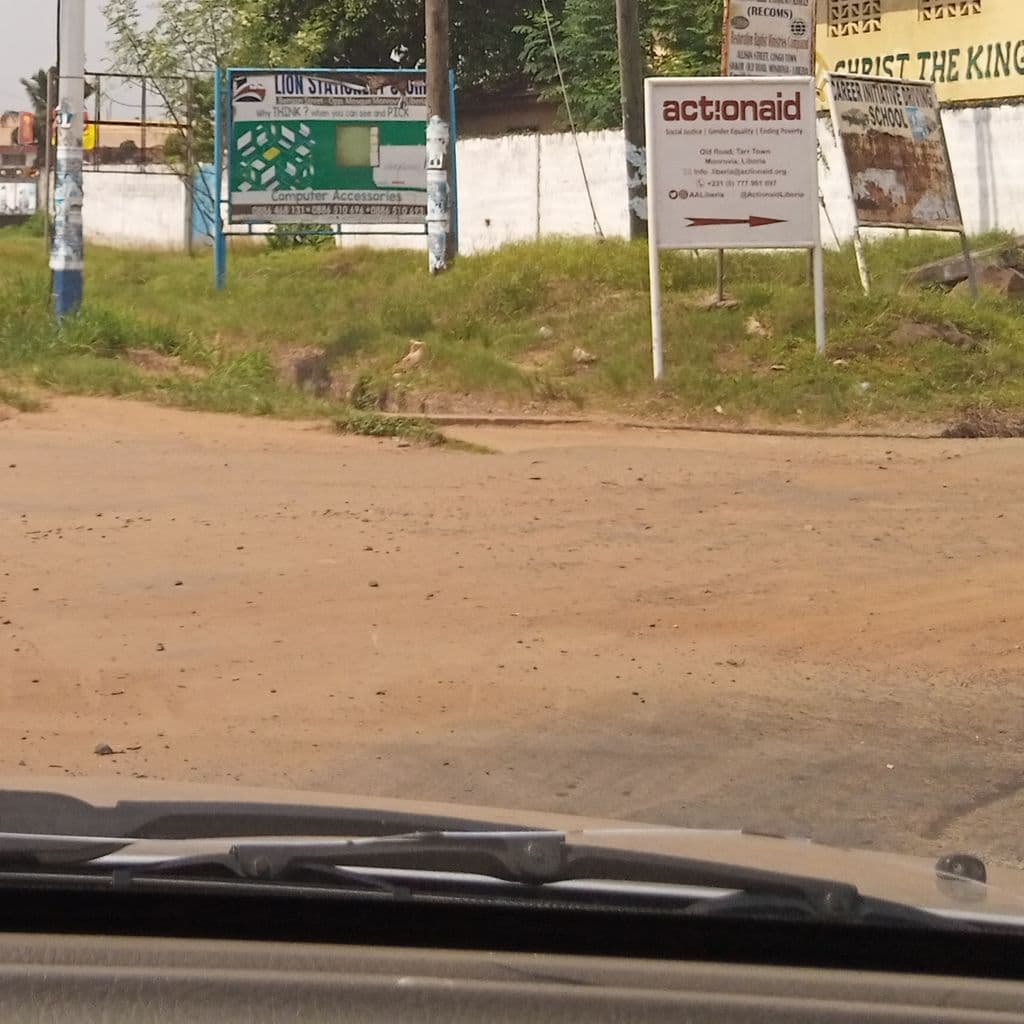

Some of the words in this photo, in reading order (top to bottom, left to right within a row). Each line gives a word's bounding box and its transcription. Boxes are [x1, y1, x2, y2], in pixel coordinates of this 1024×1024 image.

[917, 48, 961, 83] THE
[966, 40, 1024, 80] KING
[275, 74, 305, 95] LION
[830, 80, 863, 102] CAREER
[273, 106, 301, 117] THINK
[387, 105, 410, 117] PICK
[867, 105, 909, 129] SCHOOL
[699, 148, 712, 156] Old
[752, 147, 771, 155] Town
[271, 190, 327, 204] Computer
[332, 189, 403, 202] Accessories
